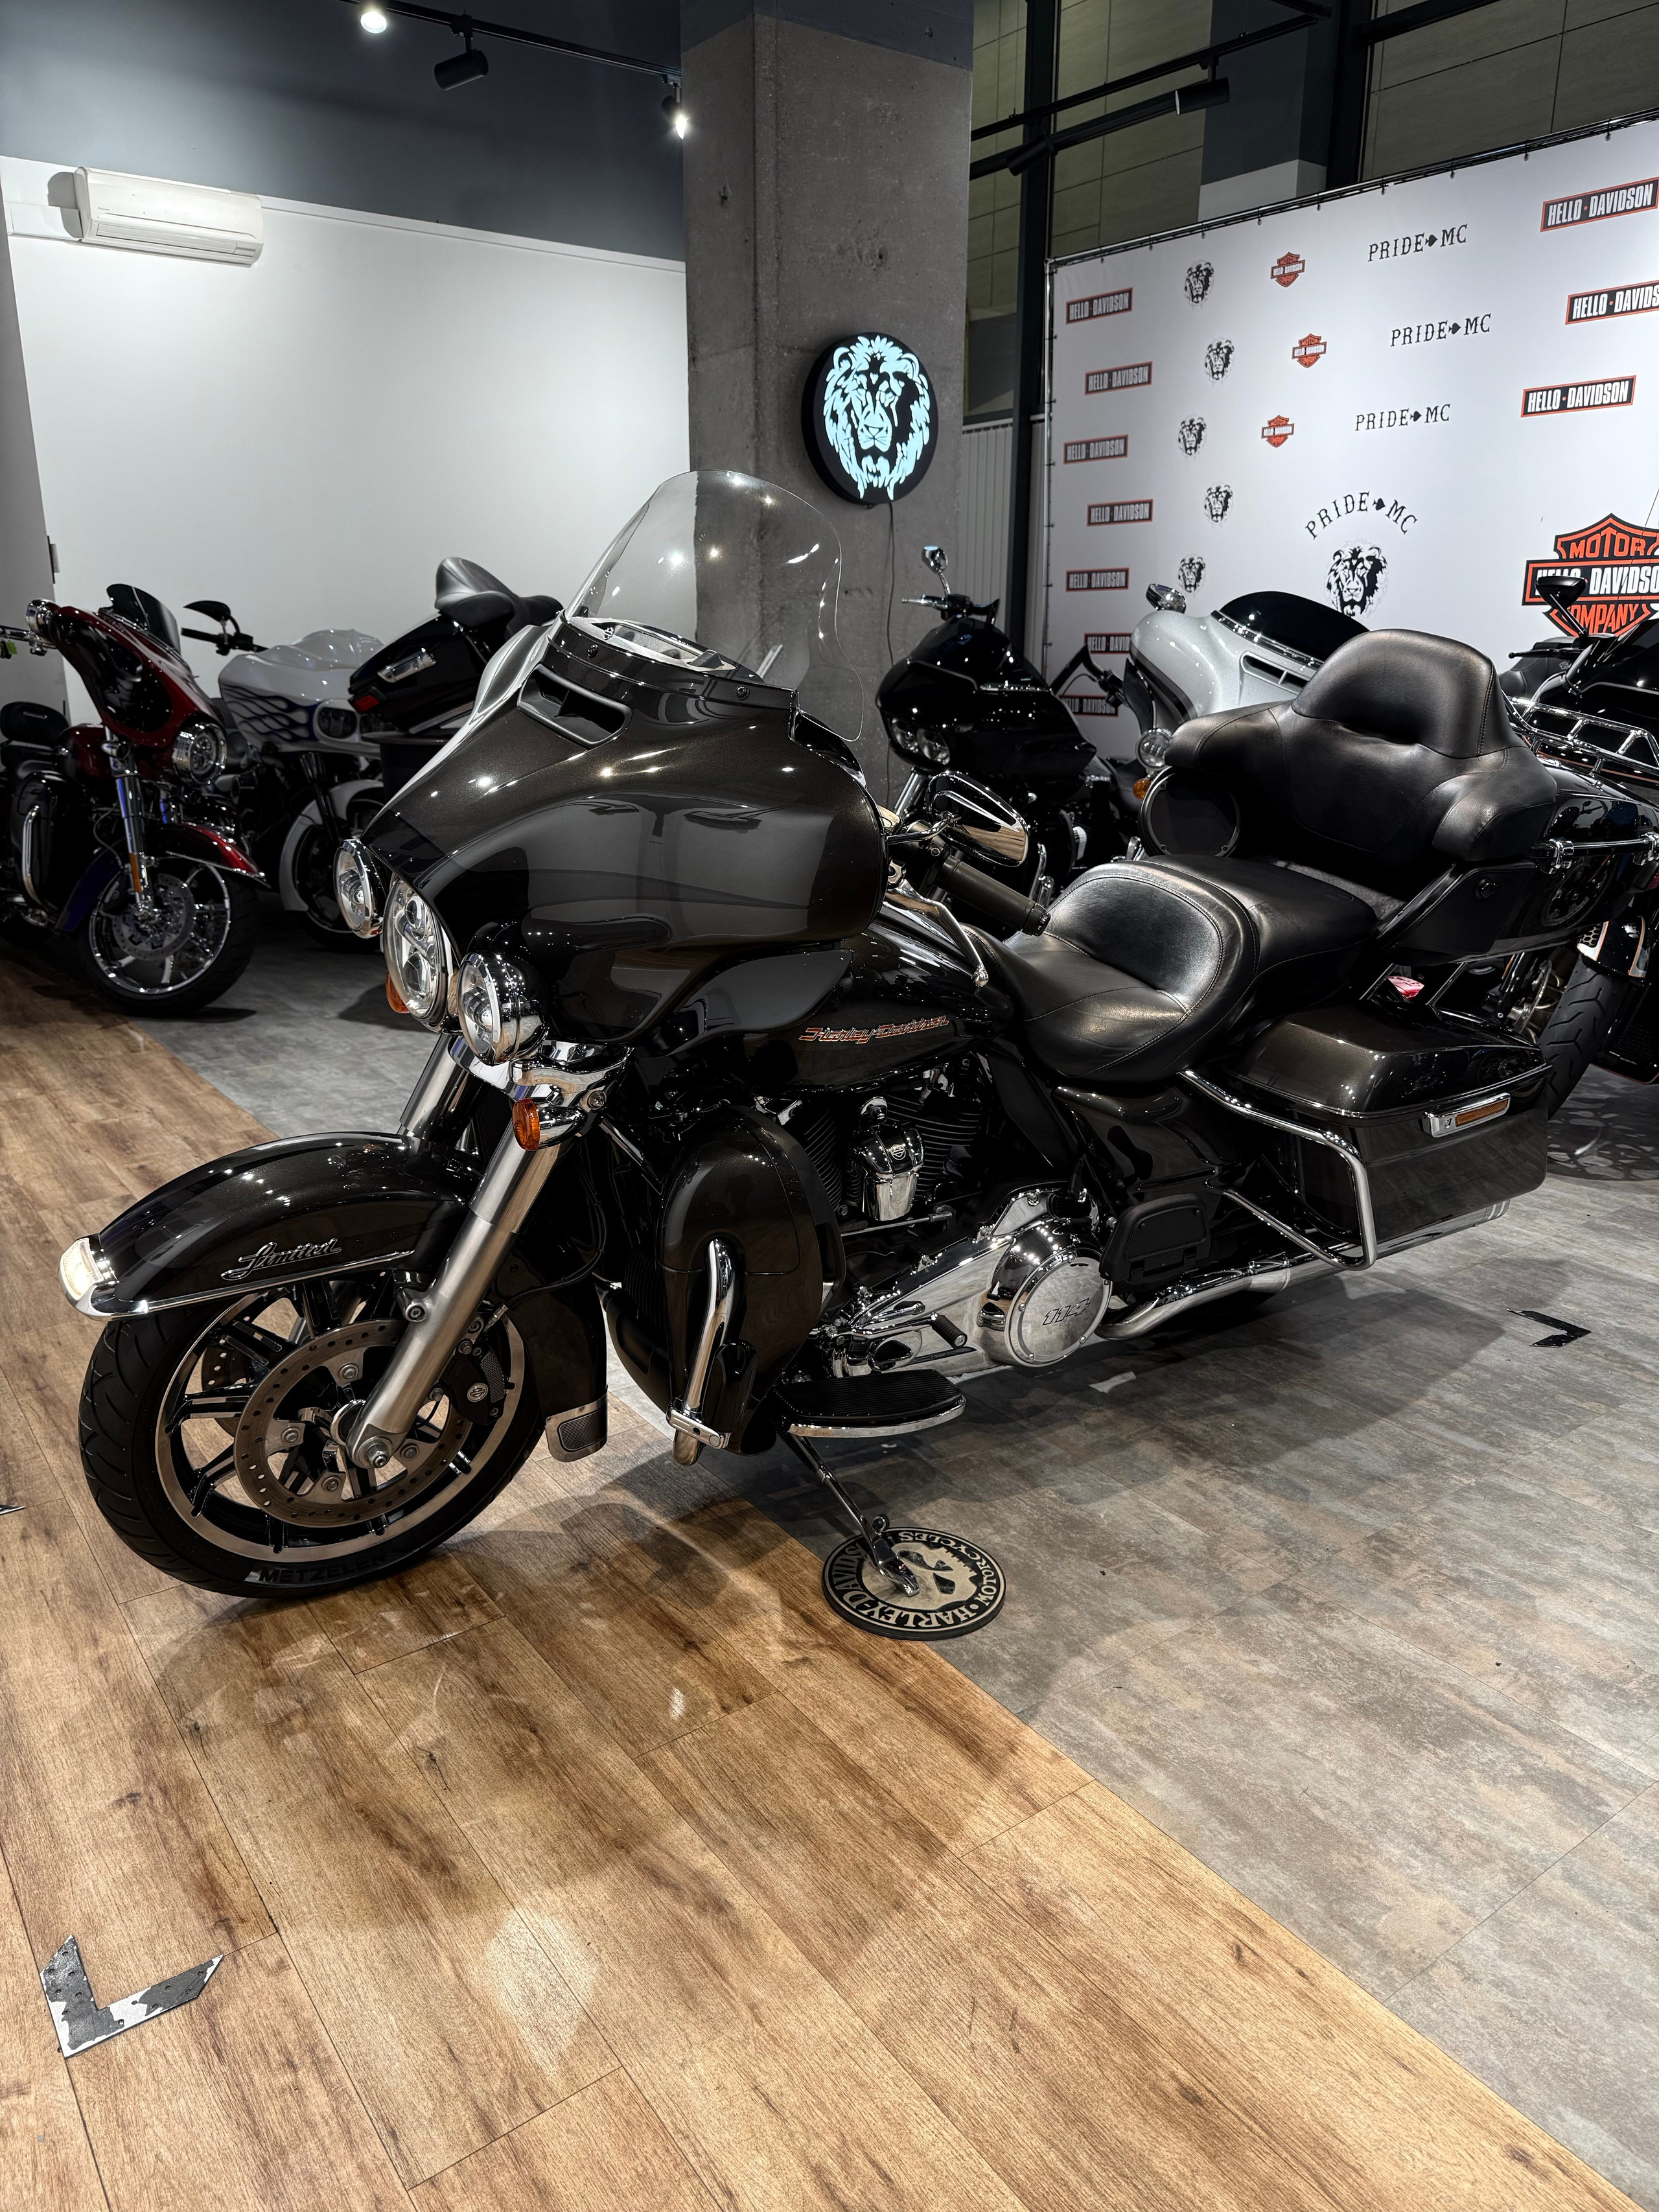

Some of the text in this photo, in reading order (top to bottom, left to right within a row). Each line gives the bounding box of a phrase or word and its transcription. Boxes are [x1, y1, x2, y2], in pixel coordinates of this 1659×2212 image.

[1548, 183, 1653, 226] HELLO DAVIDSON
[1368, 224, 1468, 262] PRIDE MC
[1069, 292, 1130, 321] HELLO DAVIDSON
[1572, 284, 1659, 320] HELLO DAVIDS
[1390, 312, 1491, 347] PRIDE MC
[1088, 366, 1149, 391] HELLO DAVIDSON
[1527, 380, 1629, 413] HELLO DAVIDSON
[1355, 403, 1450, 431] PRIDE MC
[1067, 438, 1125, 461] HELLO DAVIDSON
[1091, 502, 1150, 524] HELLO DAVIDSON
[1305, 491, 1418, 540] PRIDE MC
[1569, 526, 1646, 559] MOTOR
[1069, 571, 1126, 589] HELLO DAVIDSON
[1589, 566, 1659, 594] DAVIDSO
[1109, 636, 1130, 651] DAVID
[1062, 698, 1080, 712] LLO
[220, 1237, 342, 1281] Limited
[1042, 1298, 1091, 1325] 114
[898, 1531, 997, 1606] MOTORCYCLES
[832, 1543, 977, 1627] HARLEY-DAVIDS
